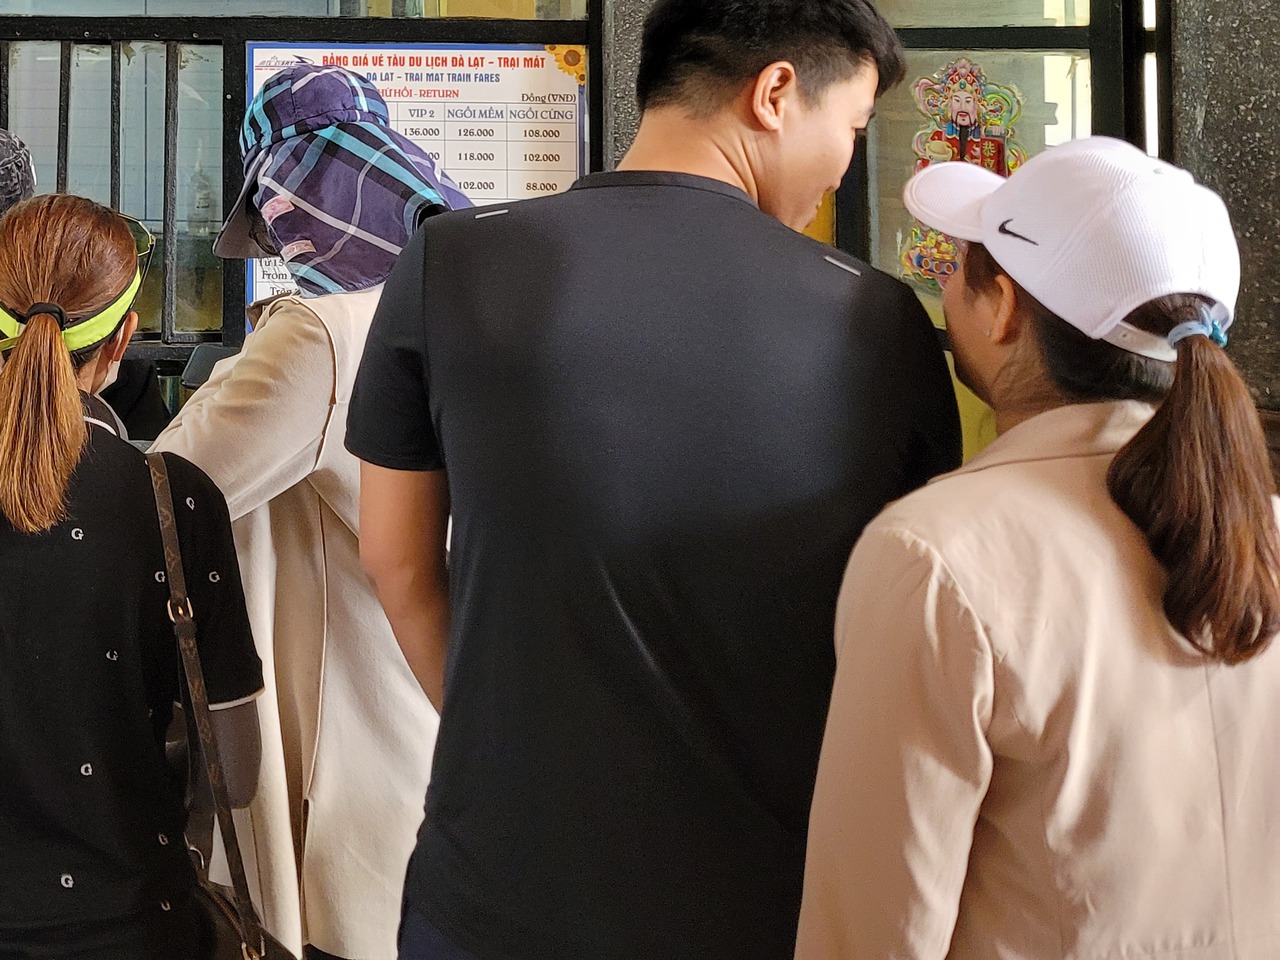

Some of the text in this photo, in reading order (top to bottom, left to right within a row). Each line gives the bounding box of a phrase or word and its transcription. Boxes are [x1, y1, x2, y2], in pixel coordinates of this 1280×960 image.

[322, 52, 546, 70] BẢNG GIÁ VÉ TÀU DU LỊCH ĐÀ LẠT TRẠI MÁT
[380, 72, 394, 82] LAT
[405, 73, 423, 82] TRAI
[426, 73, 444, 82] MAT
[447, 73, 471, 82] TRAIN
[474, 73, 501, 83] FARES
[379, 87, 394, 98] HỨ
[419, 89, 459, 98] RETURN
[521, 93, 547, 103] Đồng
[408, 109, 435, 118] VIP 2
[447, 106, 504, 119] NGỒI MỀM
[509, 106, 574, 120] NGỒI CỨNG
[404, 127, 440, 137] 136.000
[458, 128, 495, 137] 126.000
[523, 129, 560, 138] 108.000
[458, 152, 495, 161] 118.000
[523, 153, 560, 162] 102.000
[458, 181, 495, 190] 102.000
[526, 182, 558, 191] 88.000
[261, 271, 288, 280] From
[71, 527, 84, 541] G
[208, 570, 221, 583] G
[80, 763, 93, 776] G
[61, 873, 74, 888] G
